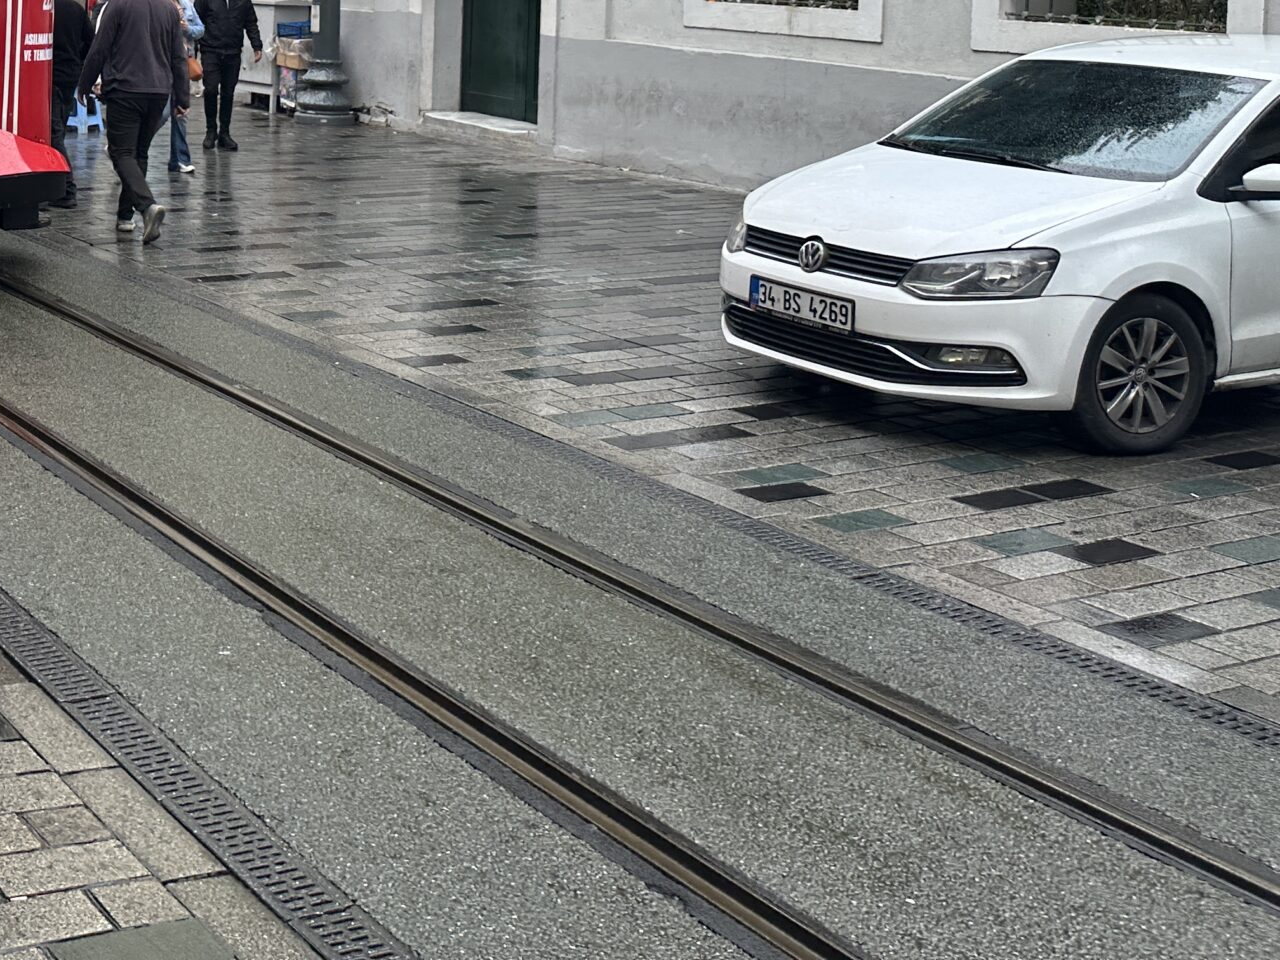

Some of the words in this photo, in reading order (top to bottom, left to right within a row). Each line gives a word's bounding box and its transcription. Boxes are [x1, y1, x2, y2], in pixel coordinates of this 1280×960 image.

[760, 283, 775, 307] 34
[783, 289, 801, 314] BS
[809, 296, 849, 326] 4269
